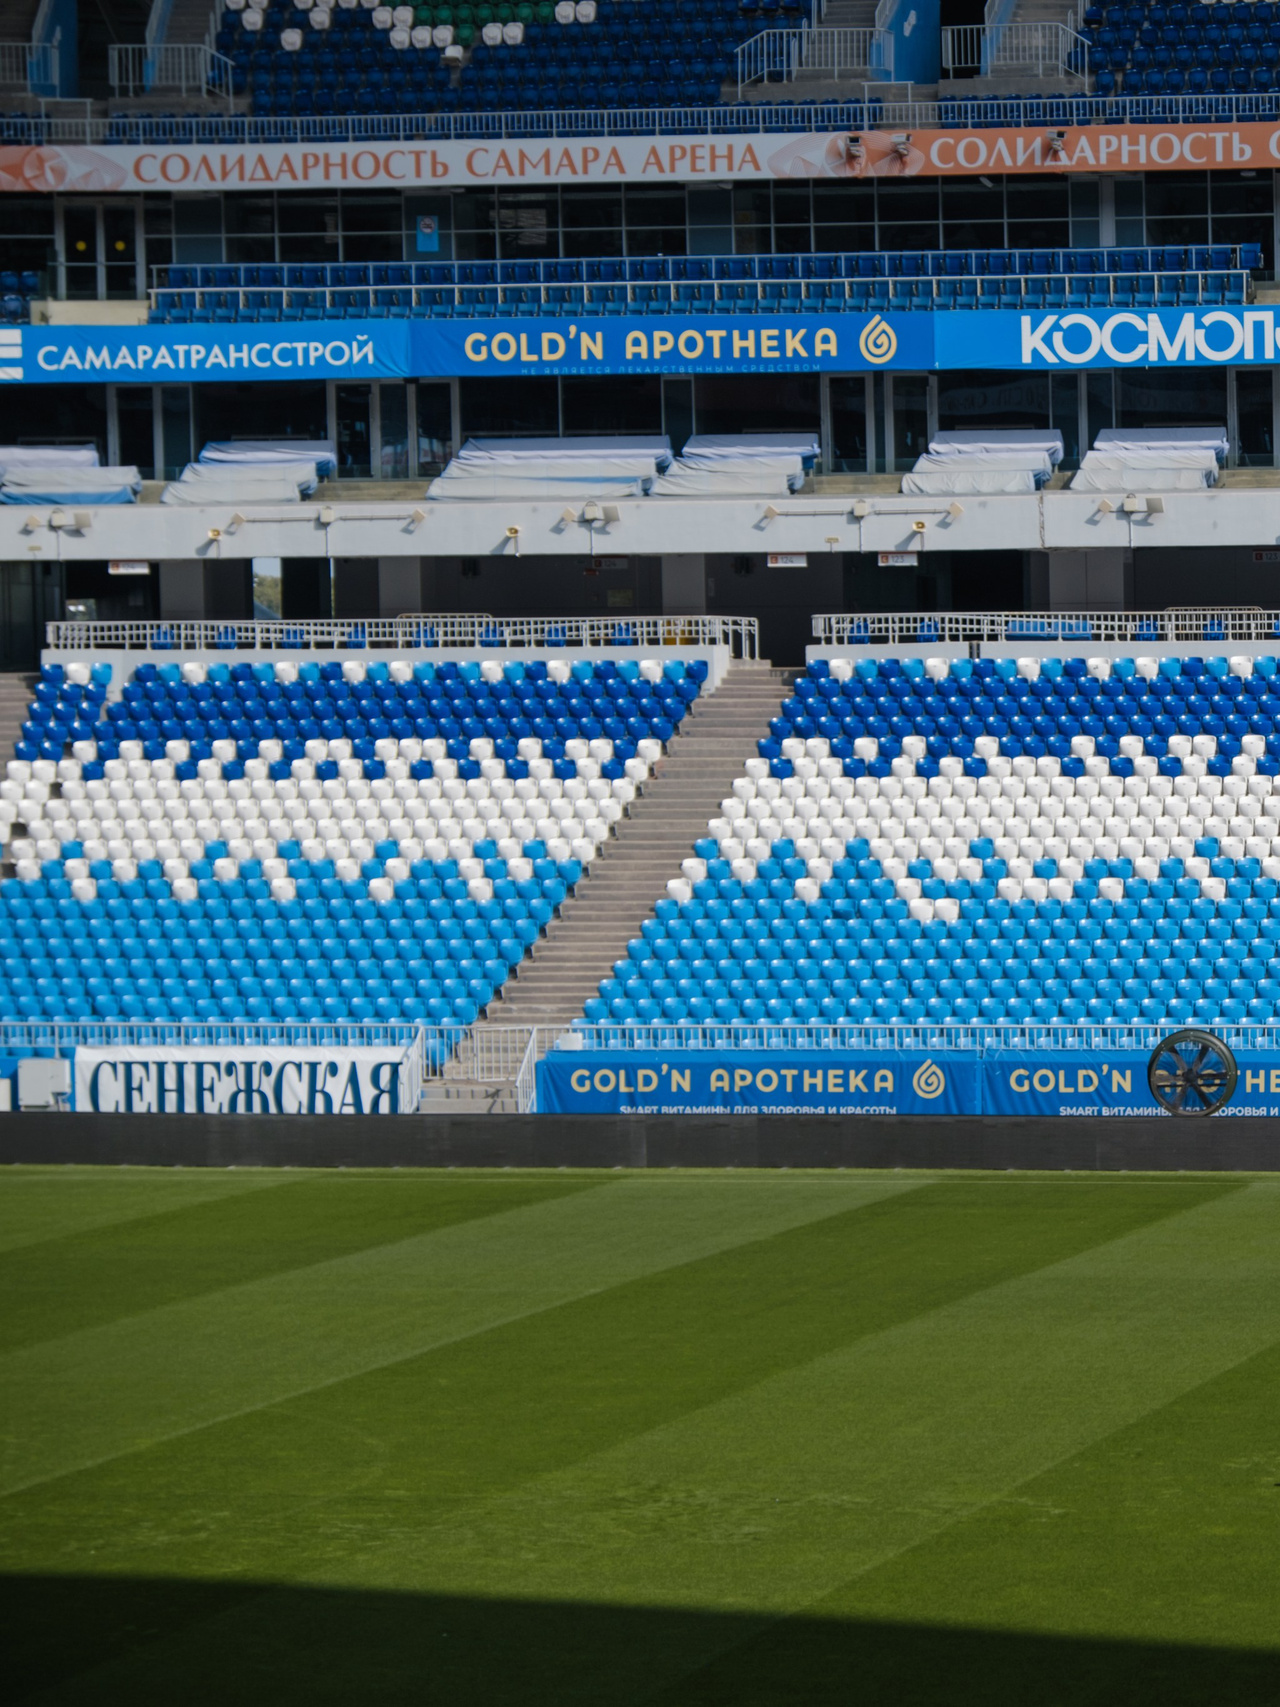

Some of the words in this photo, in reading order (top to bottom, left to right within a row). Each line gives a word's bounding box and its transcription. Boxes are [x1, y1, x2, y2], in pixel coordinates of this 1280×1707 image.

[132, 149, 449, 183] СОЛИДАРНОСТЬ
[465, 145, 626, 178] САМАРА
[641, 142, 762, 174] АРЕНА
[929, 131, 1252, 168] СОЛИДАРНОСТЬ
[36, 334, 374, 371] САМАРАТРАНССТРОЙ
[464, 324, 603, 362] GOLD'N
[625, 327, 838, 360] APOTHEKA
[544, 366, 611, 374] ЯВЛЯЕТСЯ
[619, 365, 734, 374] ЛЕКАРСТВЕННЫМ
[741, 364, 821, 372] СРЕДСТВОМ
[1265, 552, 1278, 560] 123
[89, 1060, 403, 1114] СЕНЕЖСКАЯ
[570, 1063, 691, 1093] GOLD'N
[710, 1069, 894, 1093] APOTHEKA
[1009, 1063, 1132, 1094] GOLD'N
[619, 1105, 659, 1114] SMART
[661, 1105, 731, 1114] ВИТАМИНЫ
[839, 1105, 897, 1114] КРАСОТЫ
[1059, 1106, 1099, 1116] SMART
[1270, 1106, 1278, 1116] И
